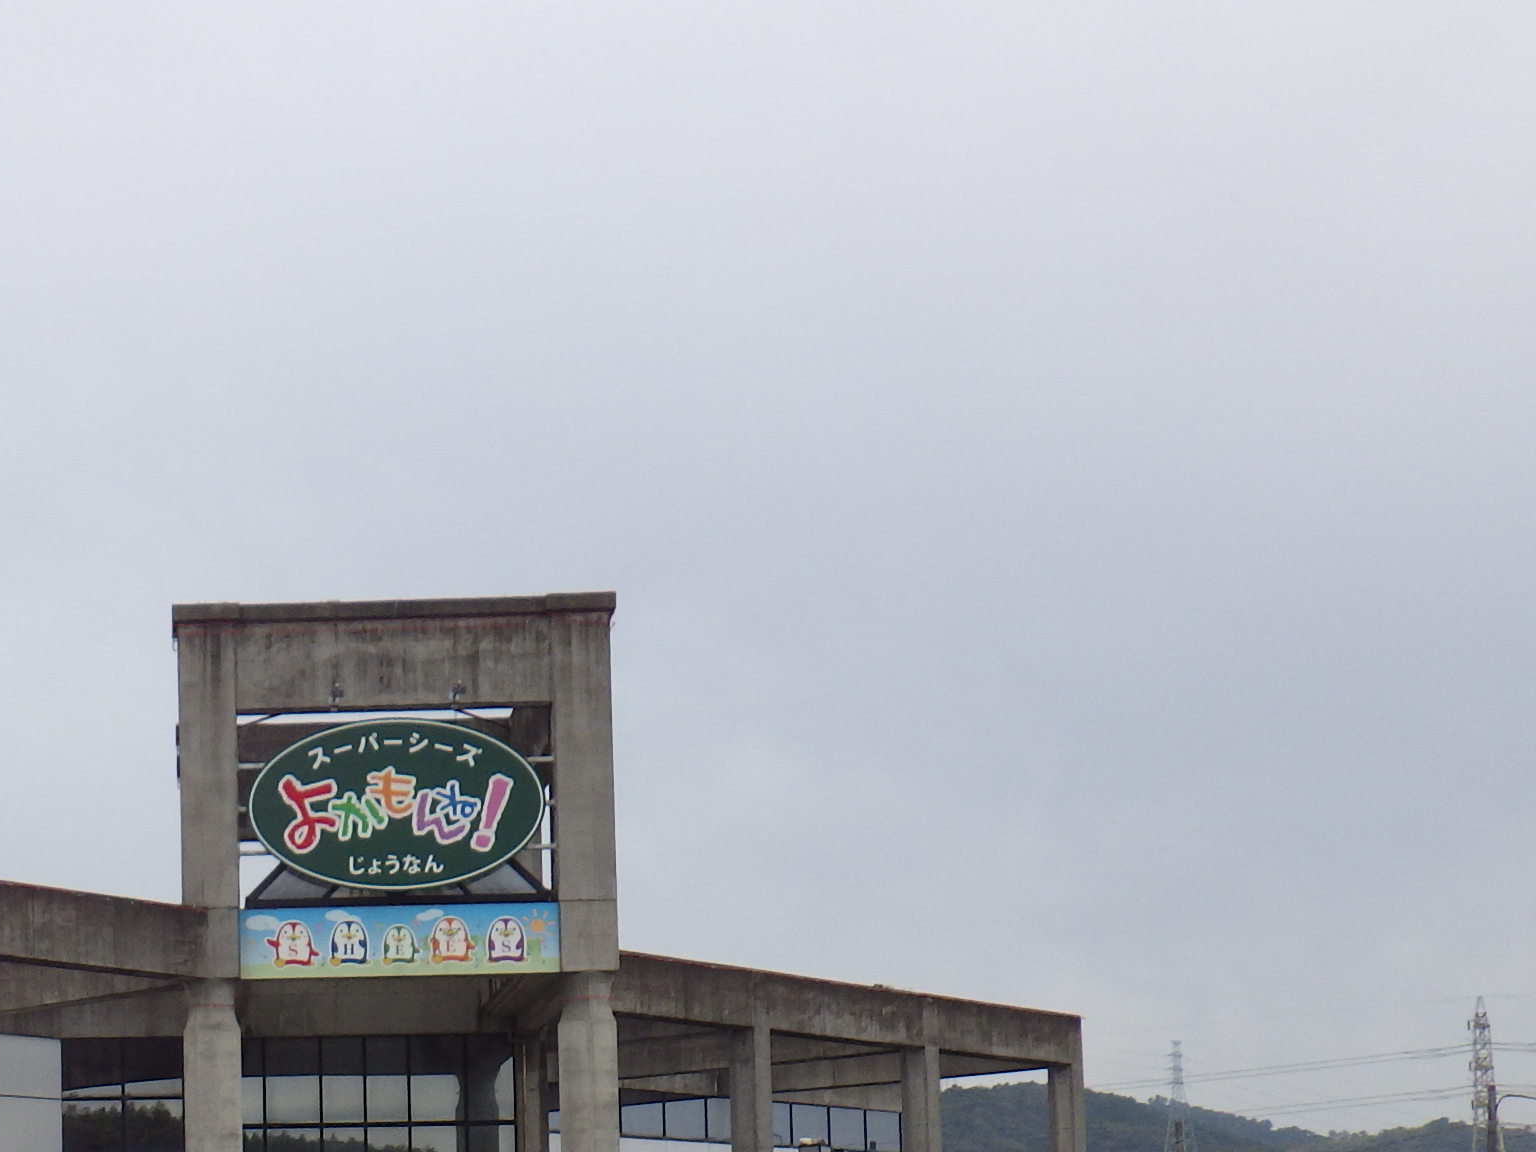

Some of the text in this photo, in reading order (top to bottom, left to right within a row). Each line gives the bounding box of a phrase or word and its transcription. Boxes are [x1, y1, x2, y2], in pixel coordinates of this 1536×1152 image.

[307, 732, 483, 769] スーパーシーズ
[348, 854, 444, 875] じょうなん
